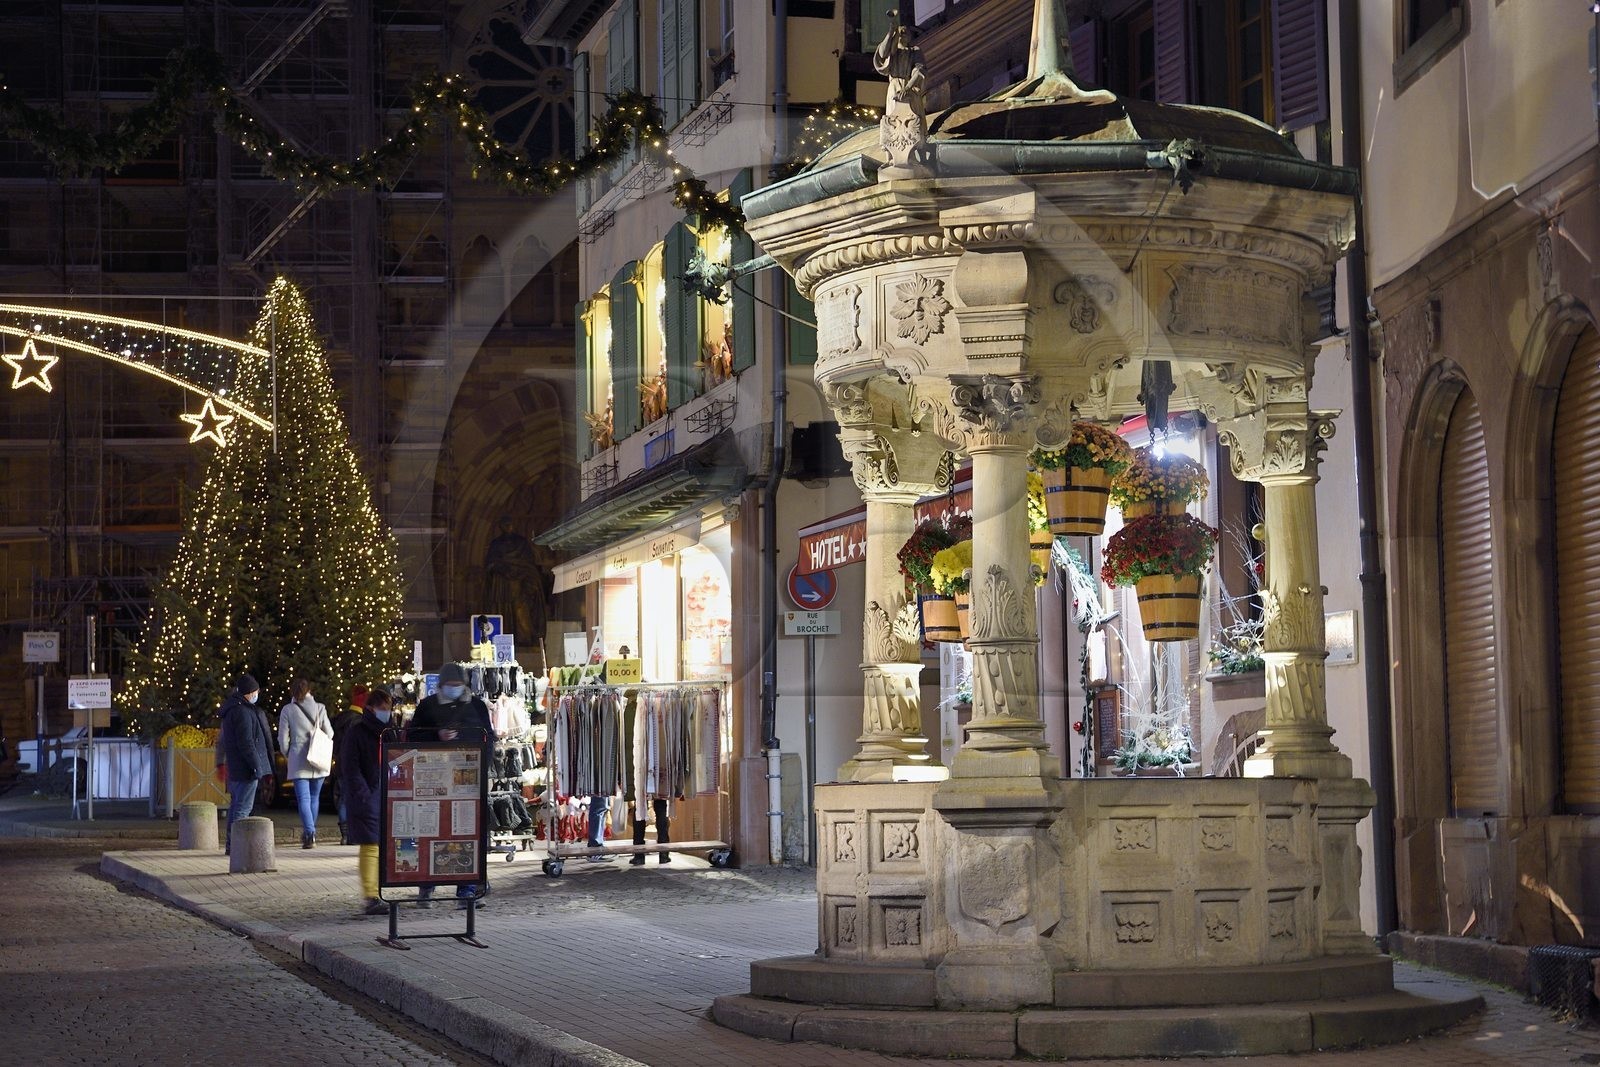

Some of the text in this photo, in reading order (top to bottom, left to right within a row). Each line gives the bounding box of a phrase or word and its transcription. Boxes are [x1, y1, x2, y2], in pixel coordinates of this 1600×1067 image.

[652, 537, 675, 559] Souvenirs
[796, 625, 829, 633] BROCHET
[609, 669, 631, 677] 10,00
